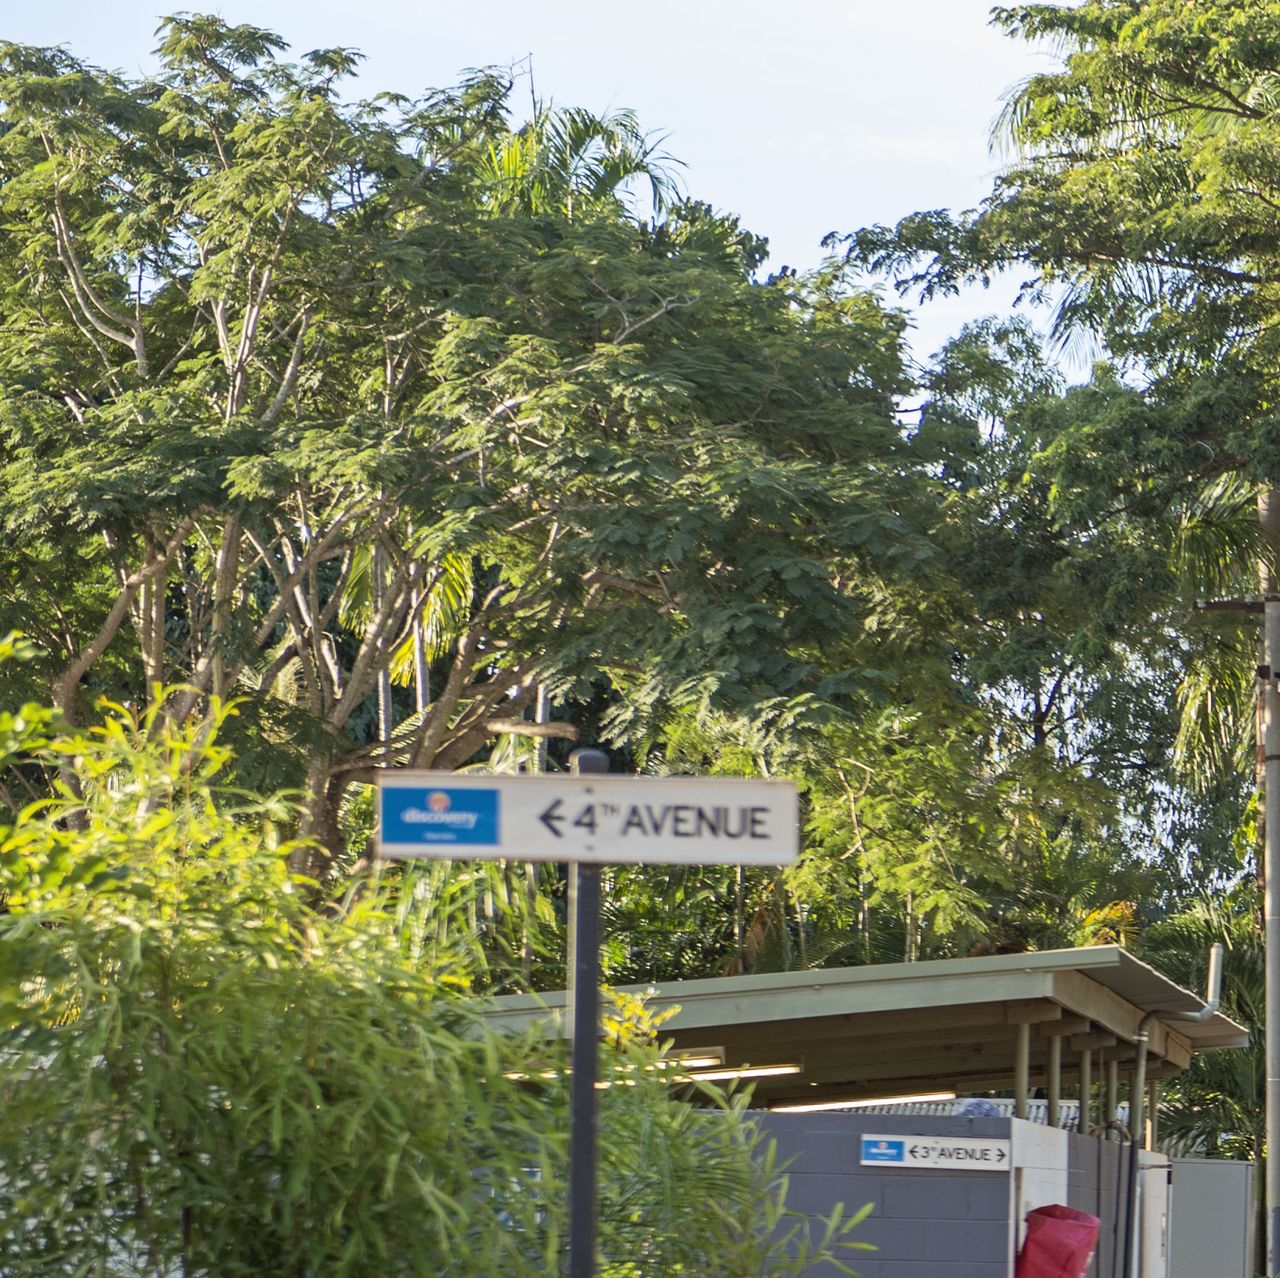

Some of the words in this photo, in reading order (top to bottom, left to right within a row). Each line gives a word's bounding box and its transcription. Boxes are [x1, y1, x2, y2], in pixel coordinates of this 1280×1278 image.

[573, 803, 620, 836] 4TH
[621, 804, 771, 839] AVENUE
[938, 1147, 992, 1161] AVENUE
